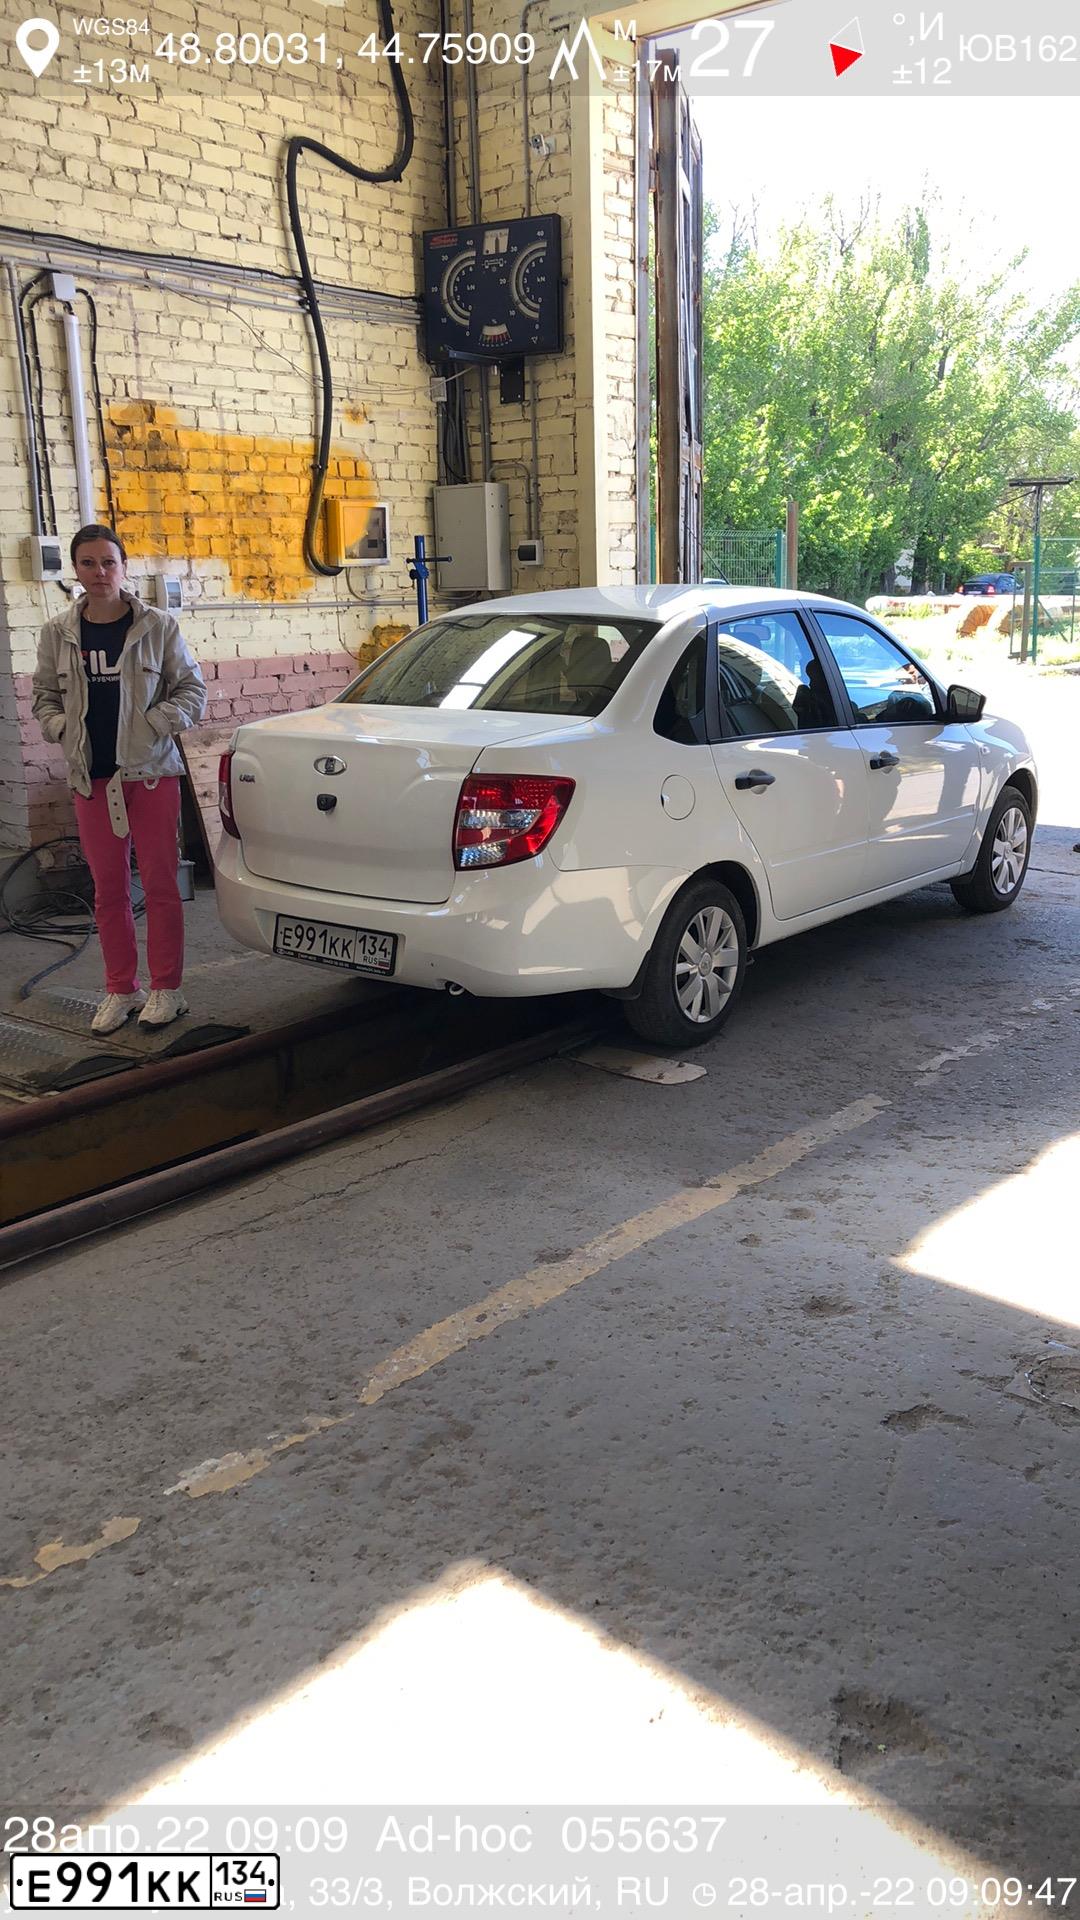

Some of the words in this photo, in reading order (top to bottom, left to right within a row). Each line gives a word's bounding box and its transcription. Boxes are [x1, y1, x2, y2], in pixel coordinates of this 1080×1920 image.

[80, 649, 122, 675] IL
[282, 924, 353, 960] Е991КК
[358, 934, 388, 958] 134
[362, 955, 378, 966] RUS
